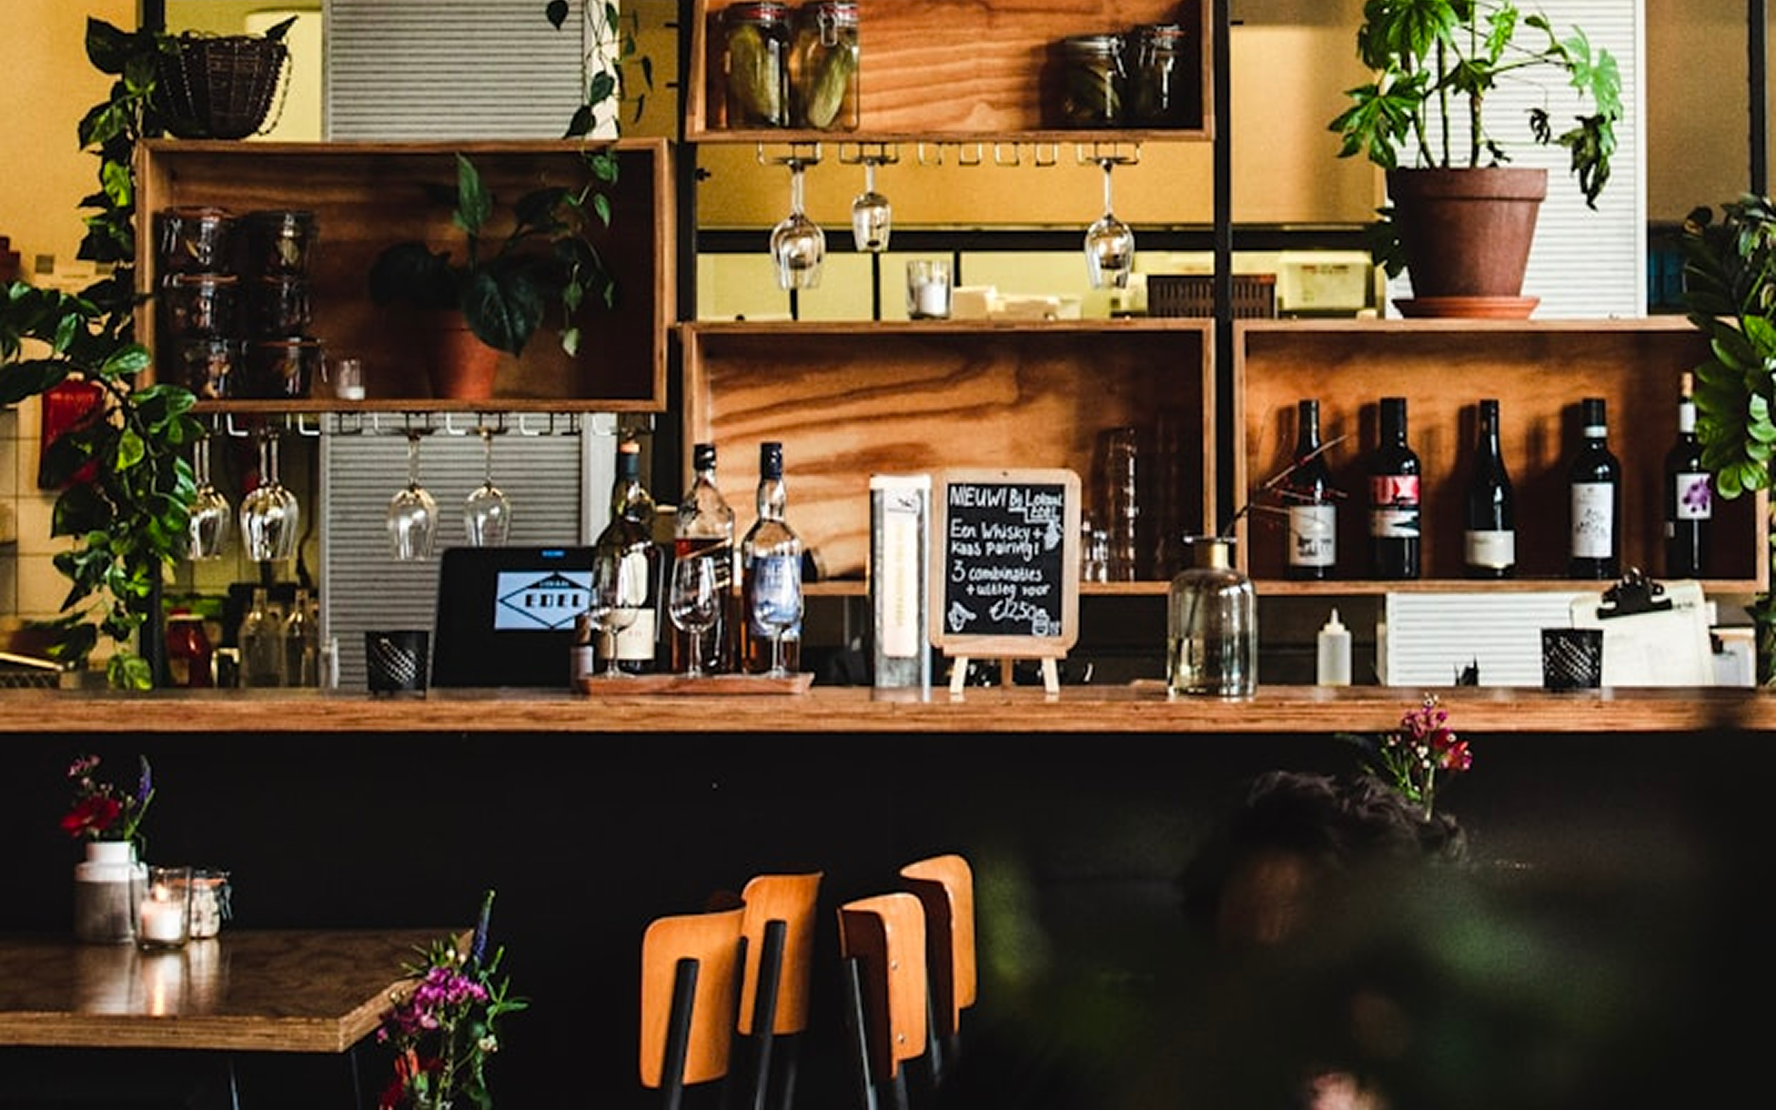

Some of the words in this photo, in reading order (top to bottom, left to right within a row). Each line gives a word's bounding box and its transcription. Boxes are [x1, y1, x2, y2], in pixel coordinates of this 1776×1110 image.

[950, 485, 1007, 507] NIEUW!
[950, 518, 977, 538] Een
[981, 521, 1031, 544] Whisky
[951, 559, 966, 582] 3
[968, 566, 1042, 582] combinaties
[525, 593, 582, 608] EDEL
[1022, 584, 1051, 597] voor
